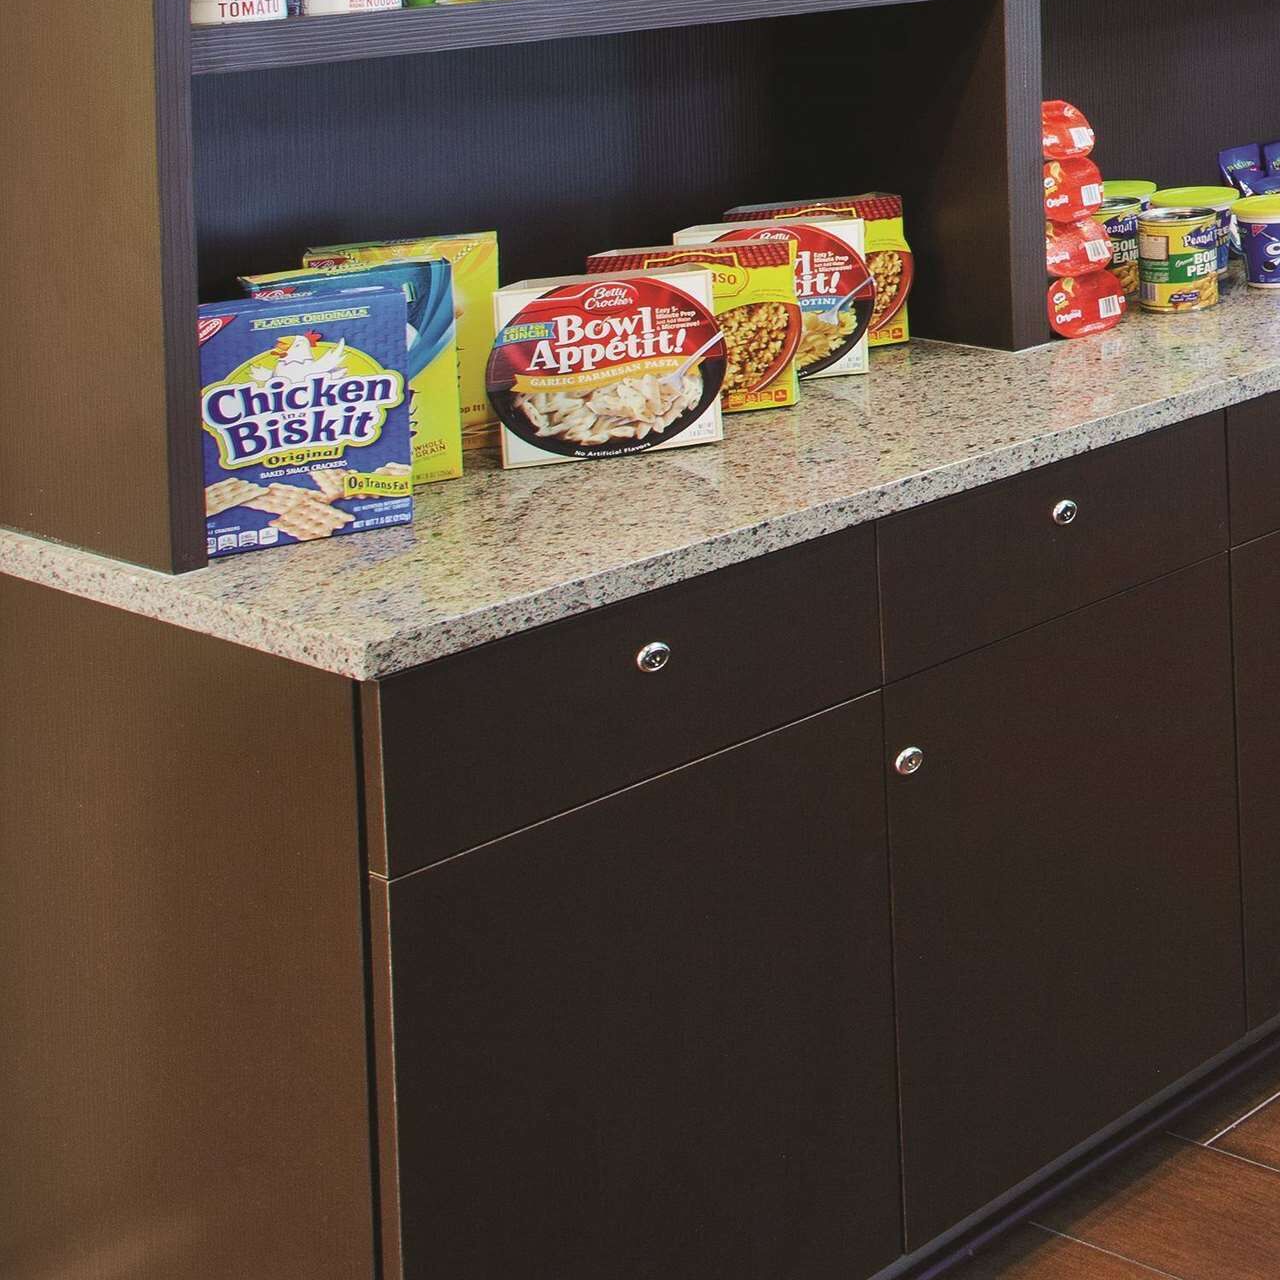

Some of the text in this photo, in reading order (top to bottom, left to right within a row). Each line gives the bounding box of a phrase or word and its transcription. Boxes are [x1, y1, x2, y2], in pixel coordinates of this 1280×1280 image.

[1112, 239, 1138, 253] BOIL
[584, 296, 635, 311] Crocker
[593, 286, 628, 301] Betty
[254, 307, 368, 330] FLAVOR ORIGINALS
[552, 307, 656, 347] Bowl
[525, 328, 688, 375] Appétit!
[530, 358, 679, 388] GARLIC PARMESAN PASTA
[206, 373, 393, 425] Chicken
[225, 405, 374, 461] Biskit
[267, 447, 340, 468] Original
[575, 449, 586, 458] No
[587, 448, 623, 458] Artificial
[311, 460, 348, 473] CRACKERS
[365, 478, 392, 490] Trans
[393, 480, 409, 490] Fat
